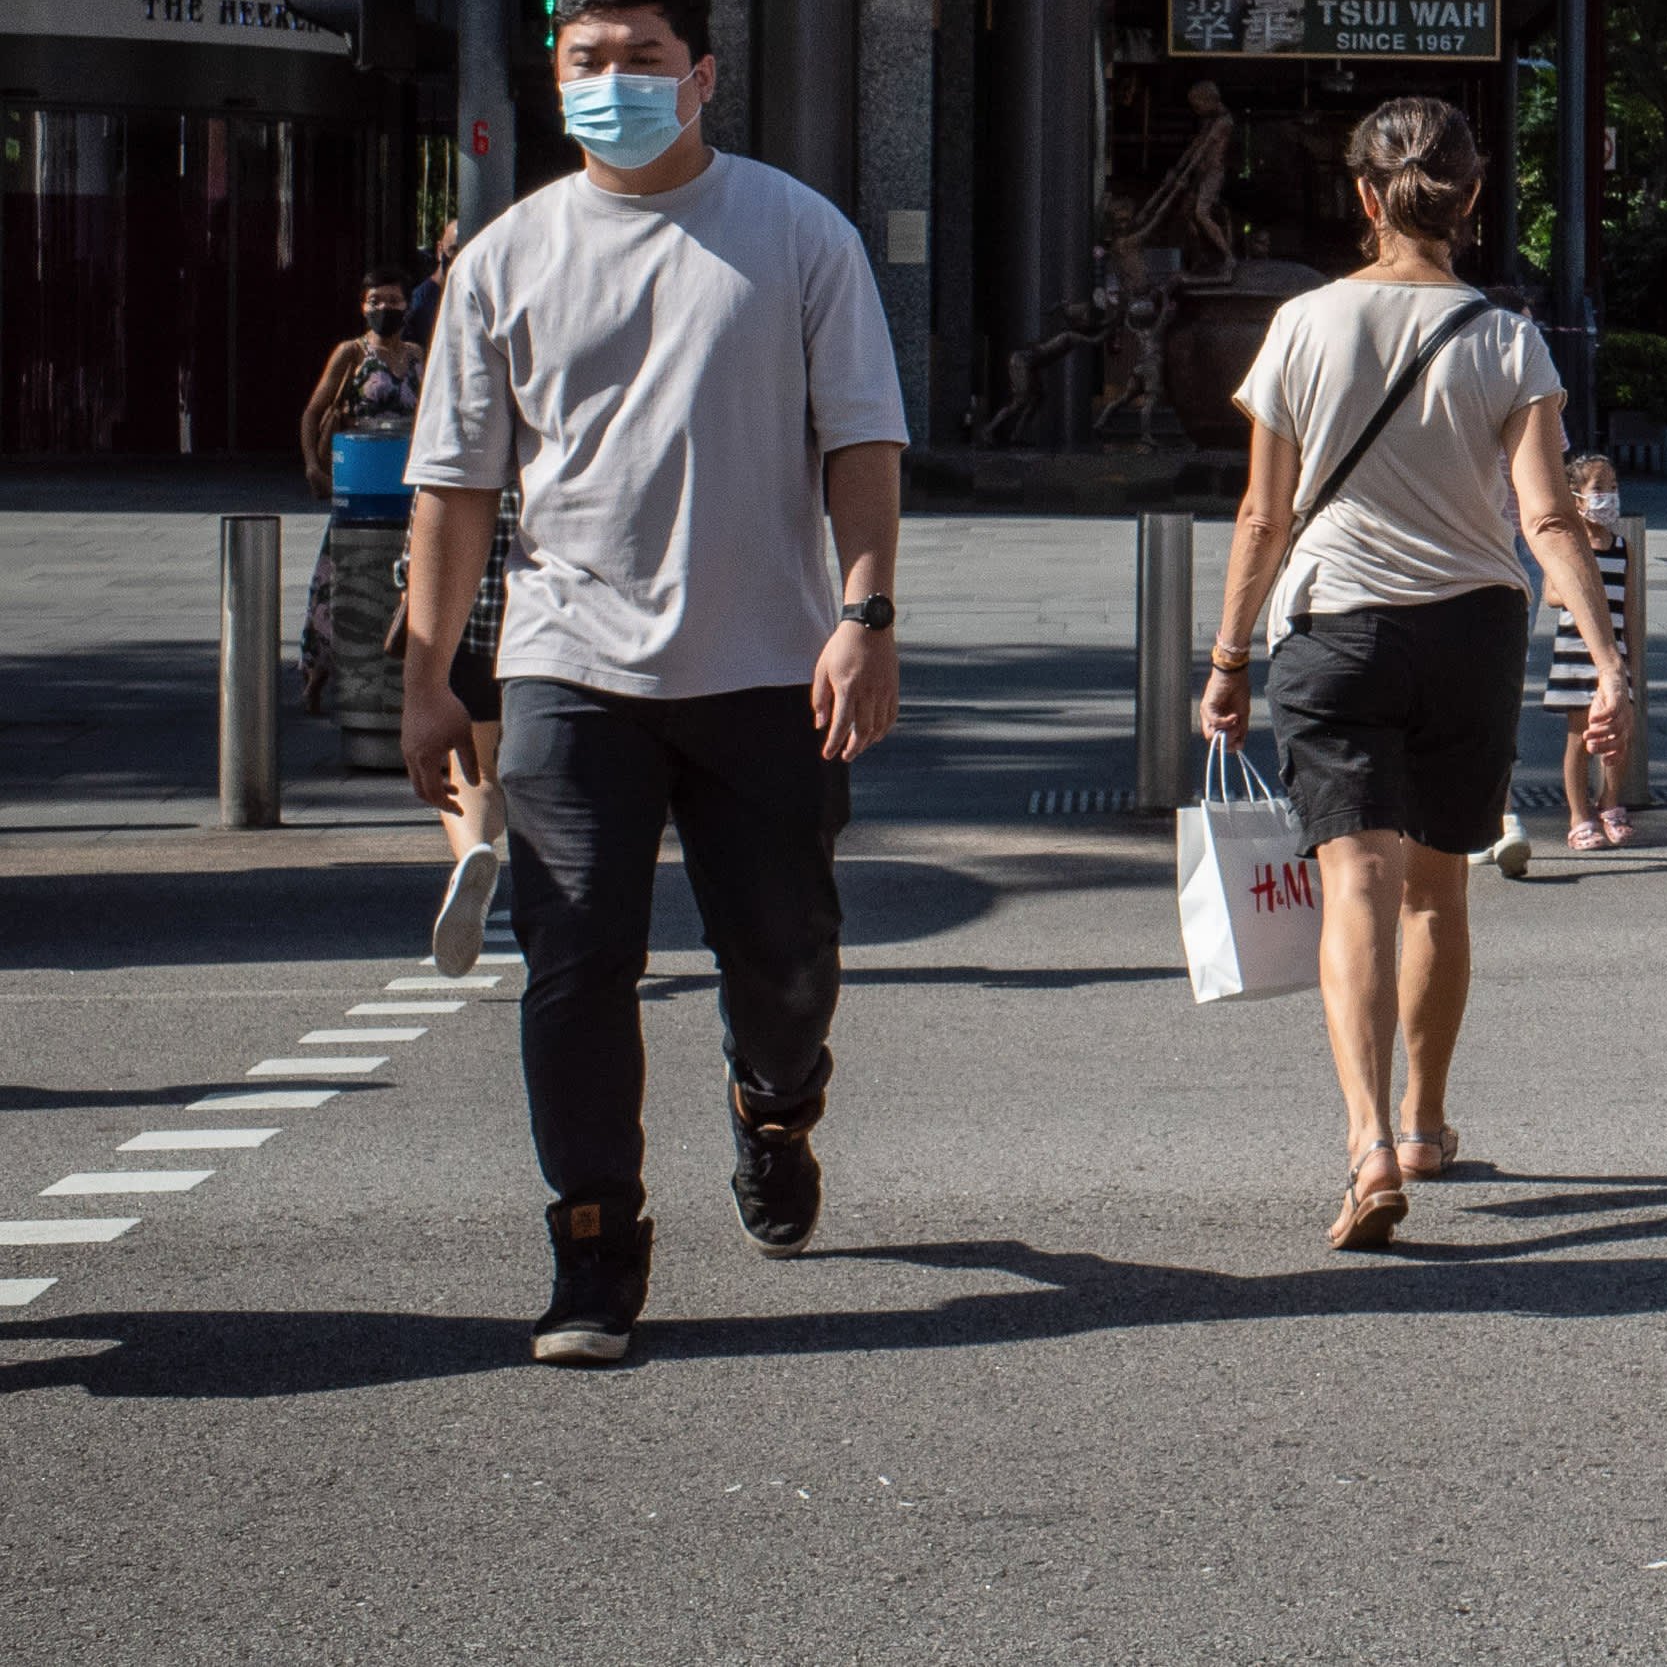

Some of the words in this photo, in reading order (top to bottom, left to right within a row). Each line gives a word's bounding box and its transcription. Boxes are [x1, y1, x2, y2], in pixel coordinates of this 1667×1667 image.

[1317, 0, 1398, 27] TSUI
[1409, 0, 1487, 29] WAH
[1336, 32, 1406, 51] SINCE
[1415, 34, 1465, 52] 1967
[1250, 861, 1315, 913] H&M
